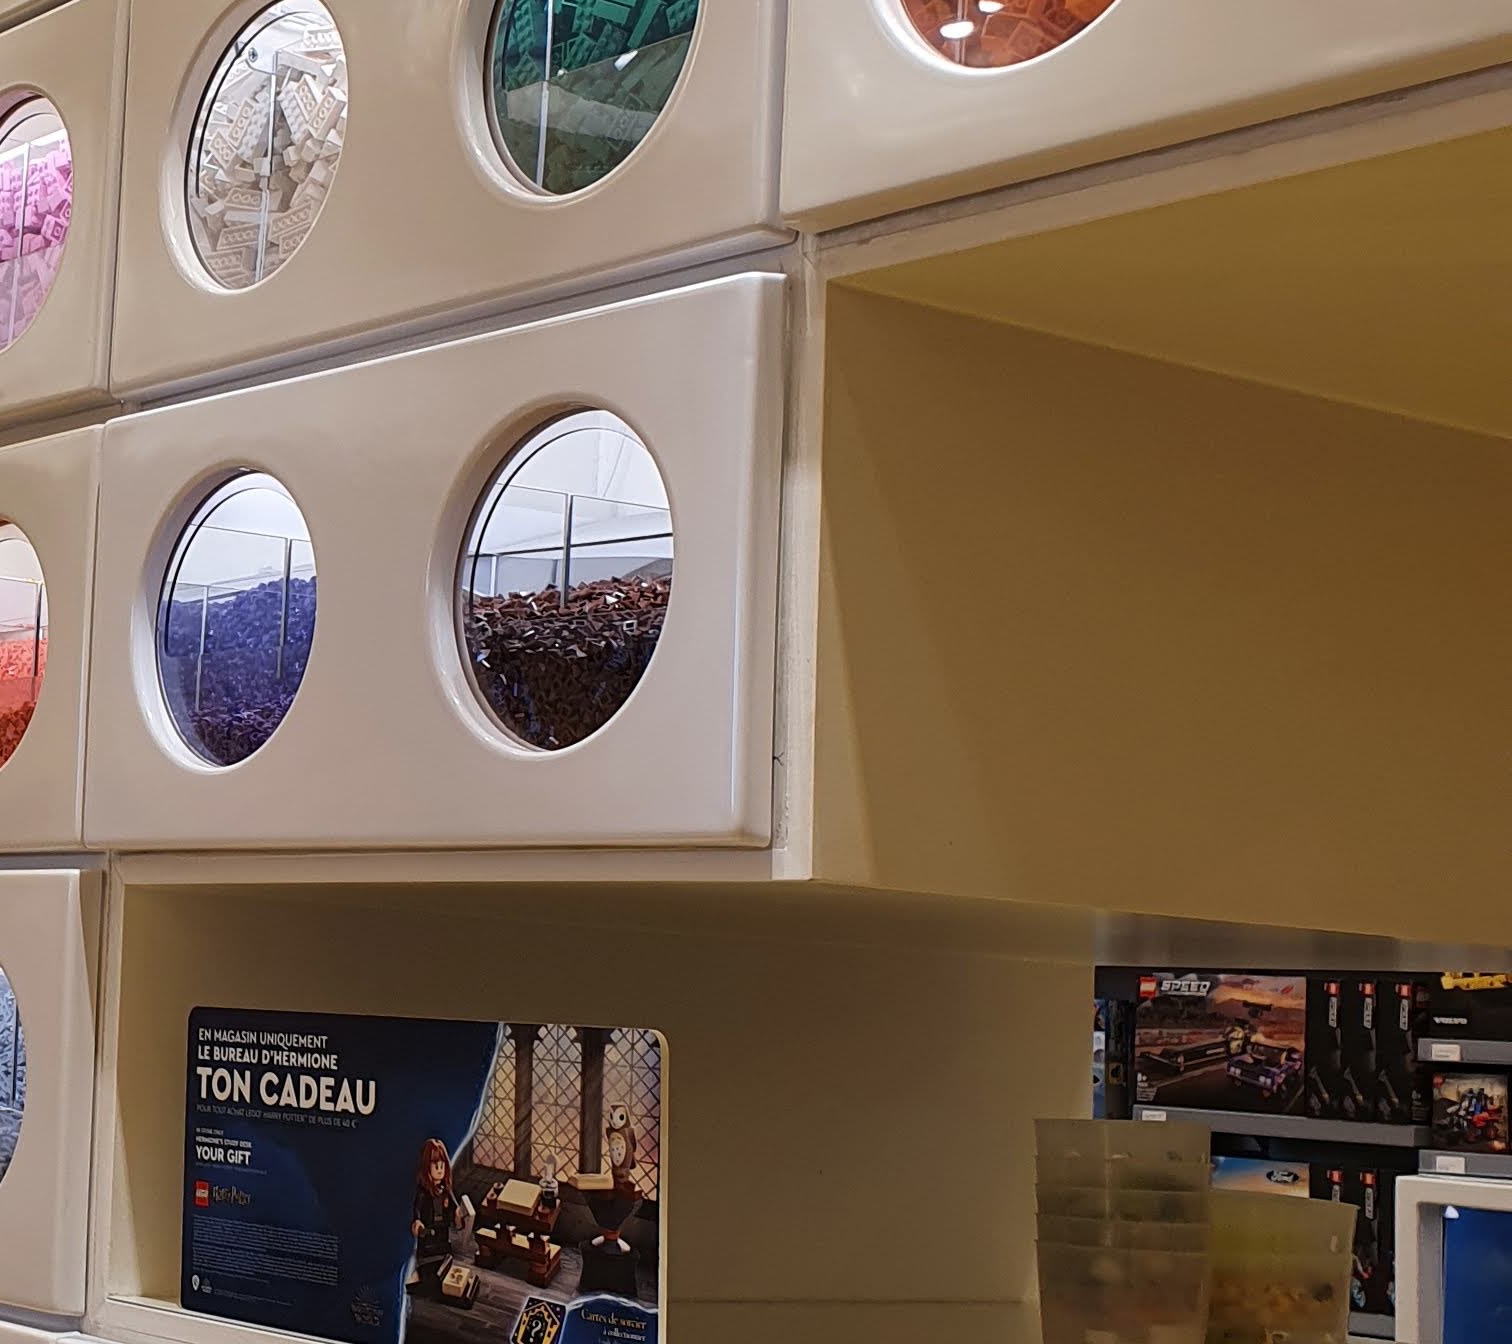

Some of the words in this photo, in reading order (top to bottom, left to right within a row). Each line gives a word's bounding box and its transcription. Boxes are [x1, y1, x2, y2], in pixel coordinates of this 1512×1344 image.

[1160, 979, 1211, 993] SPEED
[198, 1027, 212, 1042] EN
[213, 1029, 258, 1045] MAGASIN
[259, 1031, 329, 1050] UNIQUEMENT
[197, 1044, 211, 1060] LE
[213, 1046, 259, 1064] BUREAU
[261, 1049, 339, 1070] D'HERMIONE
[196, 1066, 251, 1104] TON
[259, 1071, 376, 1116] CADEAU
[195, 1145, 225, 1163] YOUR
[226, 1149, 252, 1166] GIFT
